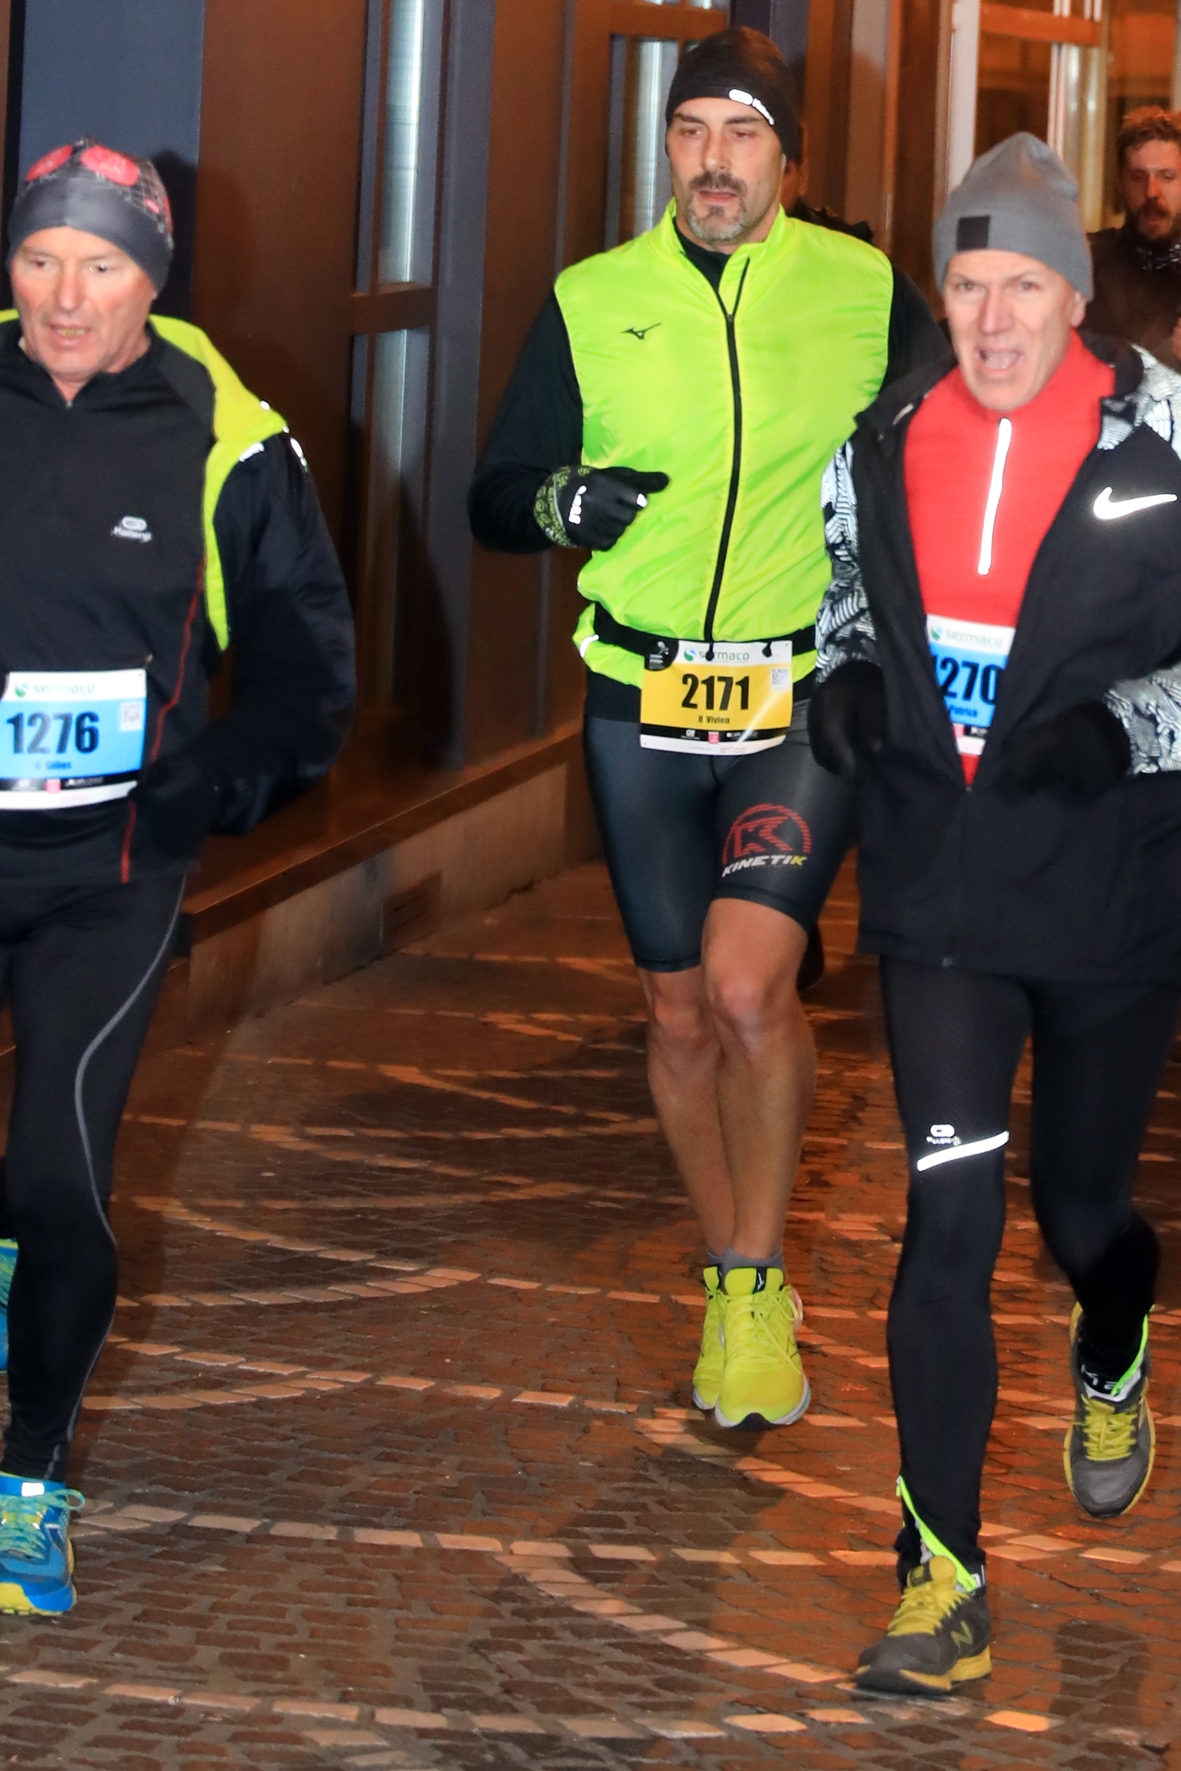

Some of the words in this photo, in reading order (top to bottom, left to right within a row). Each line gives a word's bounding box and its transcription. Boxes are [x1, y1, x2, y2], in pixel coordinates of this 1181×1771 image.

[945, 630, 1003, 648] sermaco
[698, 650, 750, 661] srmaco
[681, 673, 750, 711] 2171
[706, 716, 731, 724] Vivien
[6, 712, 99, 754] 1276
[722, 854, 808, 878] KINETIK
